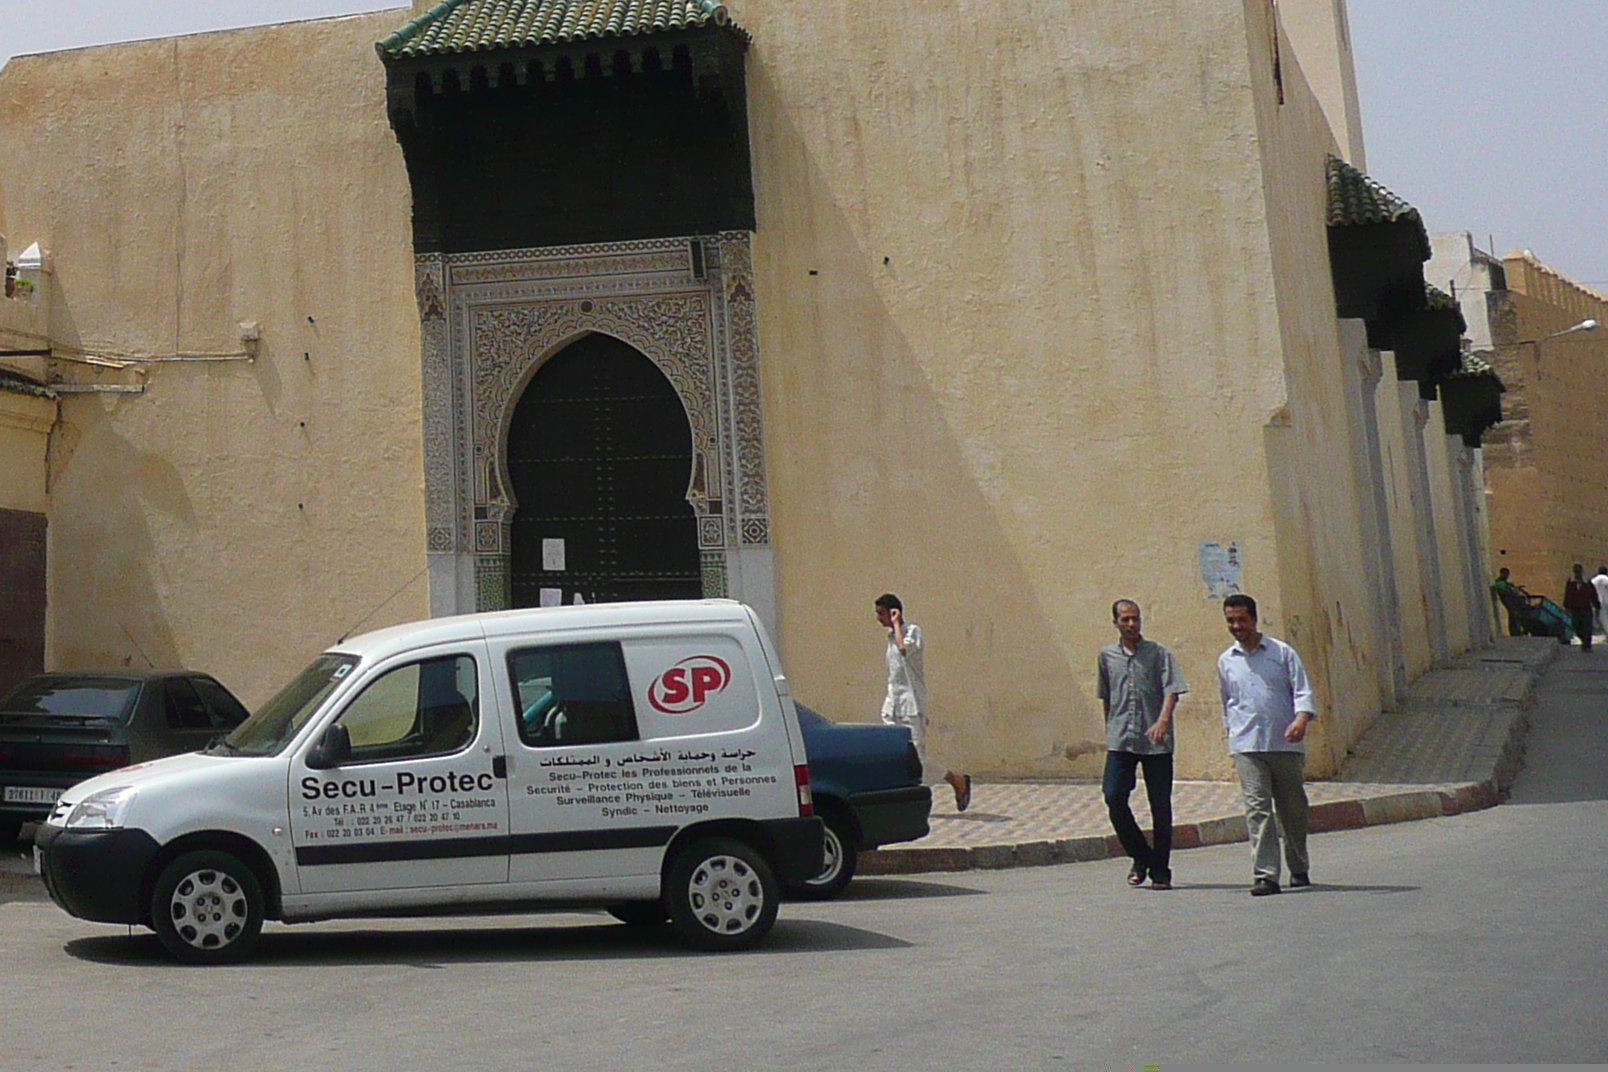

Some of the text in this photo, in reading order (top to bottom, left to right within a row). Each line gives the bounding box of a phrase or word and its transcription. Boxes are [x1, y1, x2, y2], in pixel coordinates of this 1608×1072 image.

[661, 666, 722, 704] SP
[539, 754, 601, 767] الممتلكات
[617, 748, 672, 766] الأشخاص
[677, 750, 716, 763] وحماية
[720, 748, 756, 761] حراسة
[548, 762, 752, 782] Secu-Protec les Professionnels de la
[587, 781, 644, 793] Protection
[648, 780, 668, 790] des
[671, 779, 702, 789] biens
[706, 777, 717, 787] et
[720, 774, 777, 786] Personnes
[556, 794, 621, 806] Surveillance
[625, 791, 674, 805] Physique
[690, 786, 752, 799] Télévisuelle
[325, 803, 341, 816] des
[432, 799, 440, 810] 17
[450, 798, 496, 810] Casablanca
[602, 806, 639, 819] Syndic
[654, 803, 710, 815] Nettoyage
